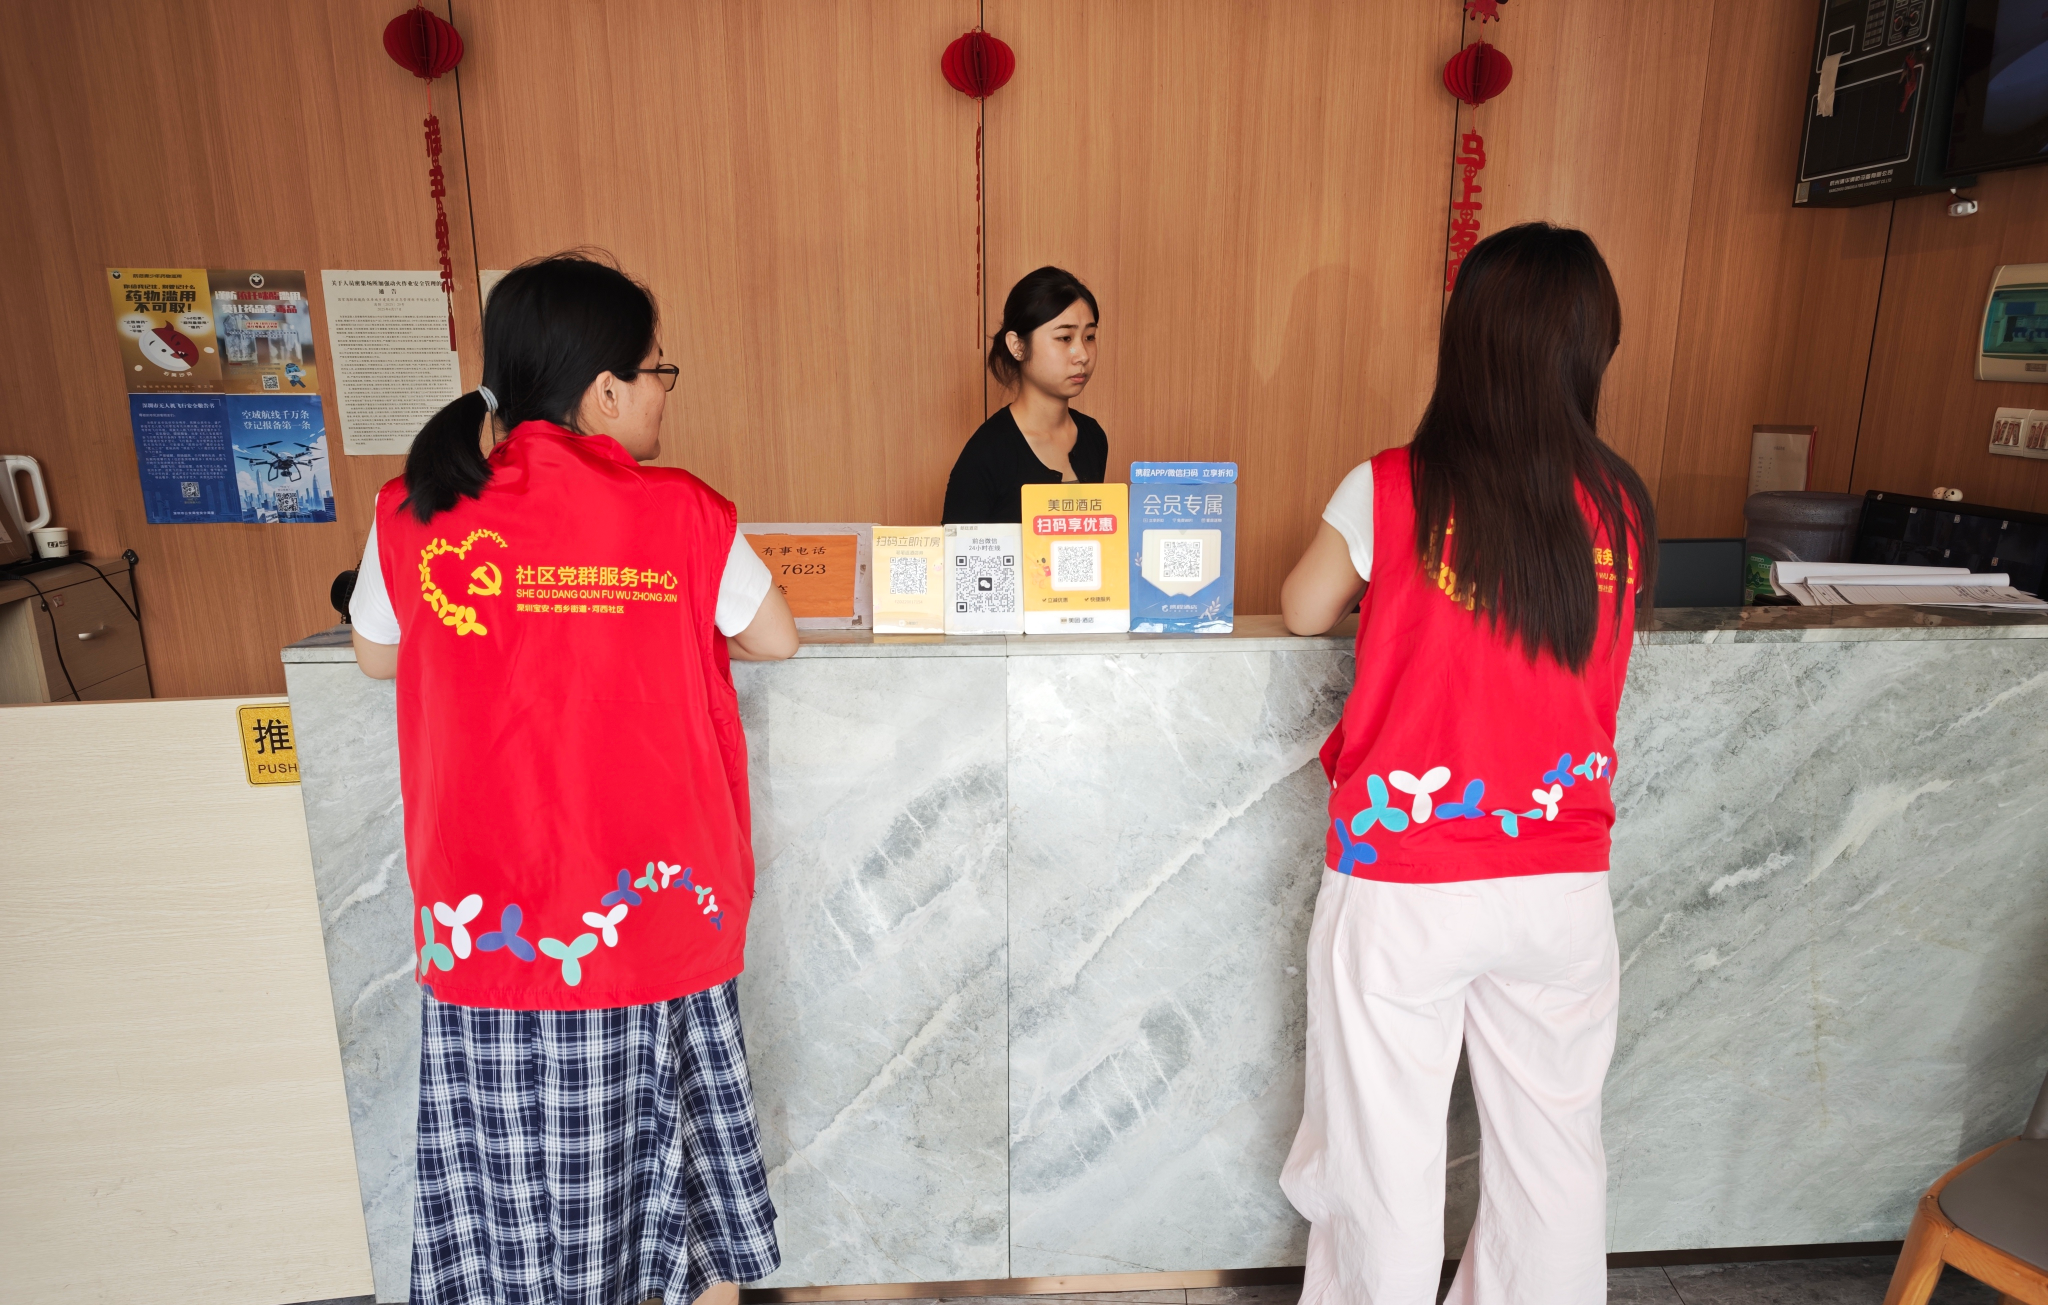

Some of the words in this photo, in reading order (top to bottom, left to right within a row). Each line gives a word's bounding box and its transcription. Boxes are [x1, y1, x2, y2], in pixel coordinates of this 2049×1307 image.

[125, 290, 196, 302] 药物滥用
[134, 302, 192, 313] 不可取！
[242, 410, 310, 420] 空域航线千万条
[243, 420, 311, 430] 登记报备第一条
[1135, 468, 1198, 478] 携程APP/微信扫码
[1202, 468, 1234, 478] 立享折扣
[1047, 498, 1102, 512] 美团酒店
[1143, 494, 1223, 515] 会员专属
[1036, 517, 1114, 533] 扫码享优惠
[876, 535, 941, 548] 扫码立即订房
[971, 537, 998, 545] 前台微信
[761, 545, 827, 556] 有事电话
[781, 563, 827, 575] 7623
[515, 565, 678, 590] 社区党群服务中心
[516, 589, 535, 599] SHE
[536, 589, 551, 599] QU
[551, 589, 578, 599] DANG
[579, 589, 600, 599] QUN
[602, 590, 614, 599] FU
[616, 590, 631, 600] WU
[632, 591, 662, 602] ZHONG
[663, 593, 678, 603] XIN
[516, 603, 625, 614] 深圳宝安·西乡街道·河西社区
[253, 719, 293, 754] 推
[258, 763, 298, 774] PUSH
